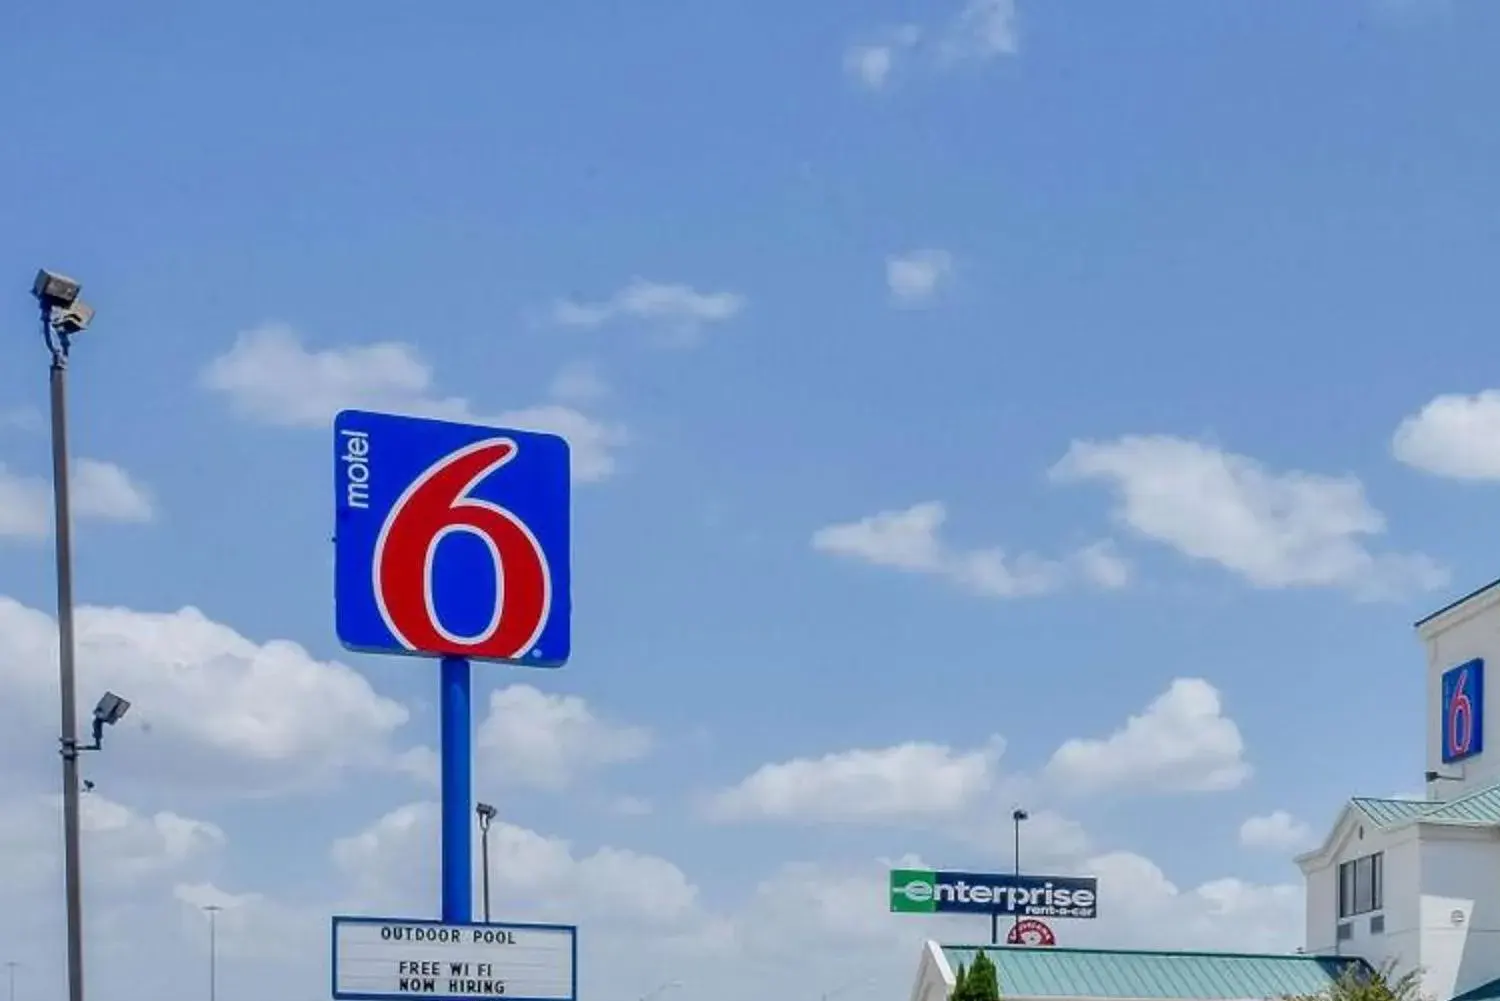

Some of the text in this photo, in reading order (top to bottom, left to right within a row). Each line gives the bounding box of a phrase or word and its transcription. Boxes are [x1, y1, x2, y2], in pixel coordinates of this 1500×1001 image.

[341, 429, 369, 509] motel
[372, 437, 552, 659] 6
[1449, 669, 1472, 757] 6
[893, 879, 1095, 910] enterprise
[381, 926, 516, 945] OUTDOOR POOL
[399, 961, 492, 977] FREE WI FI
[399, 978, 505, 995] NOW HIRING
